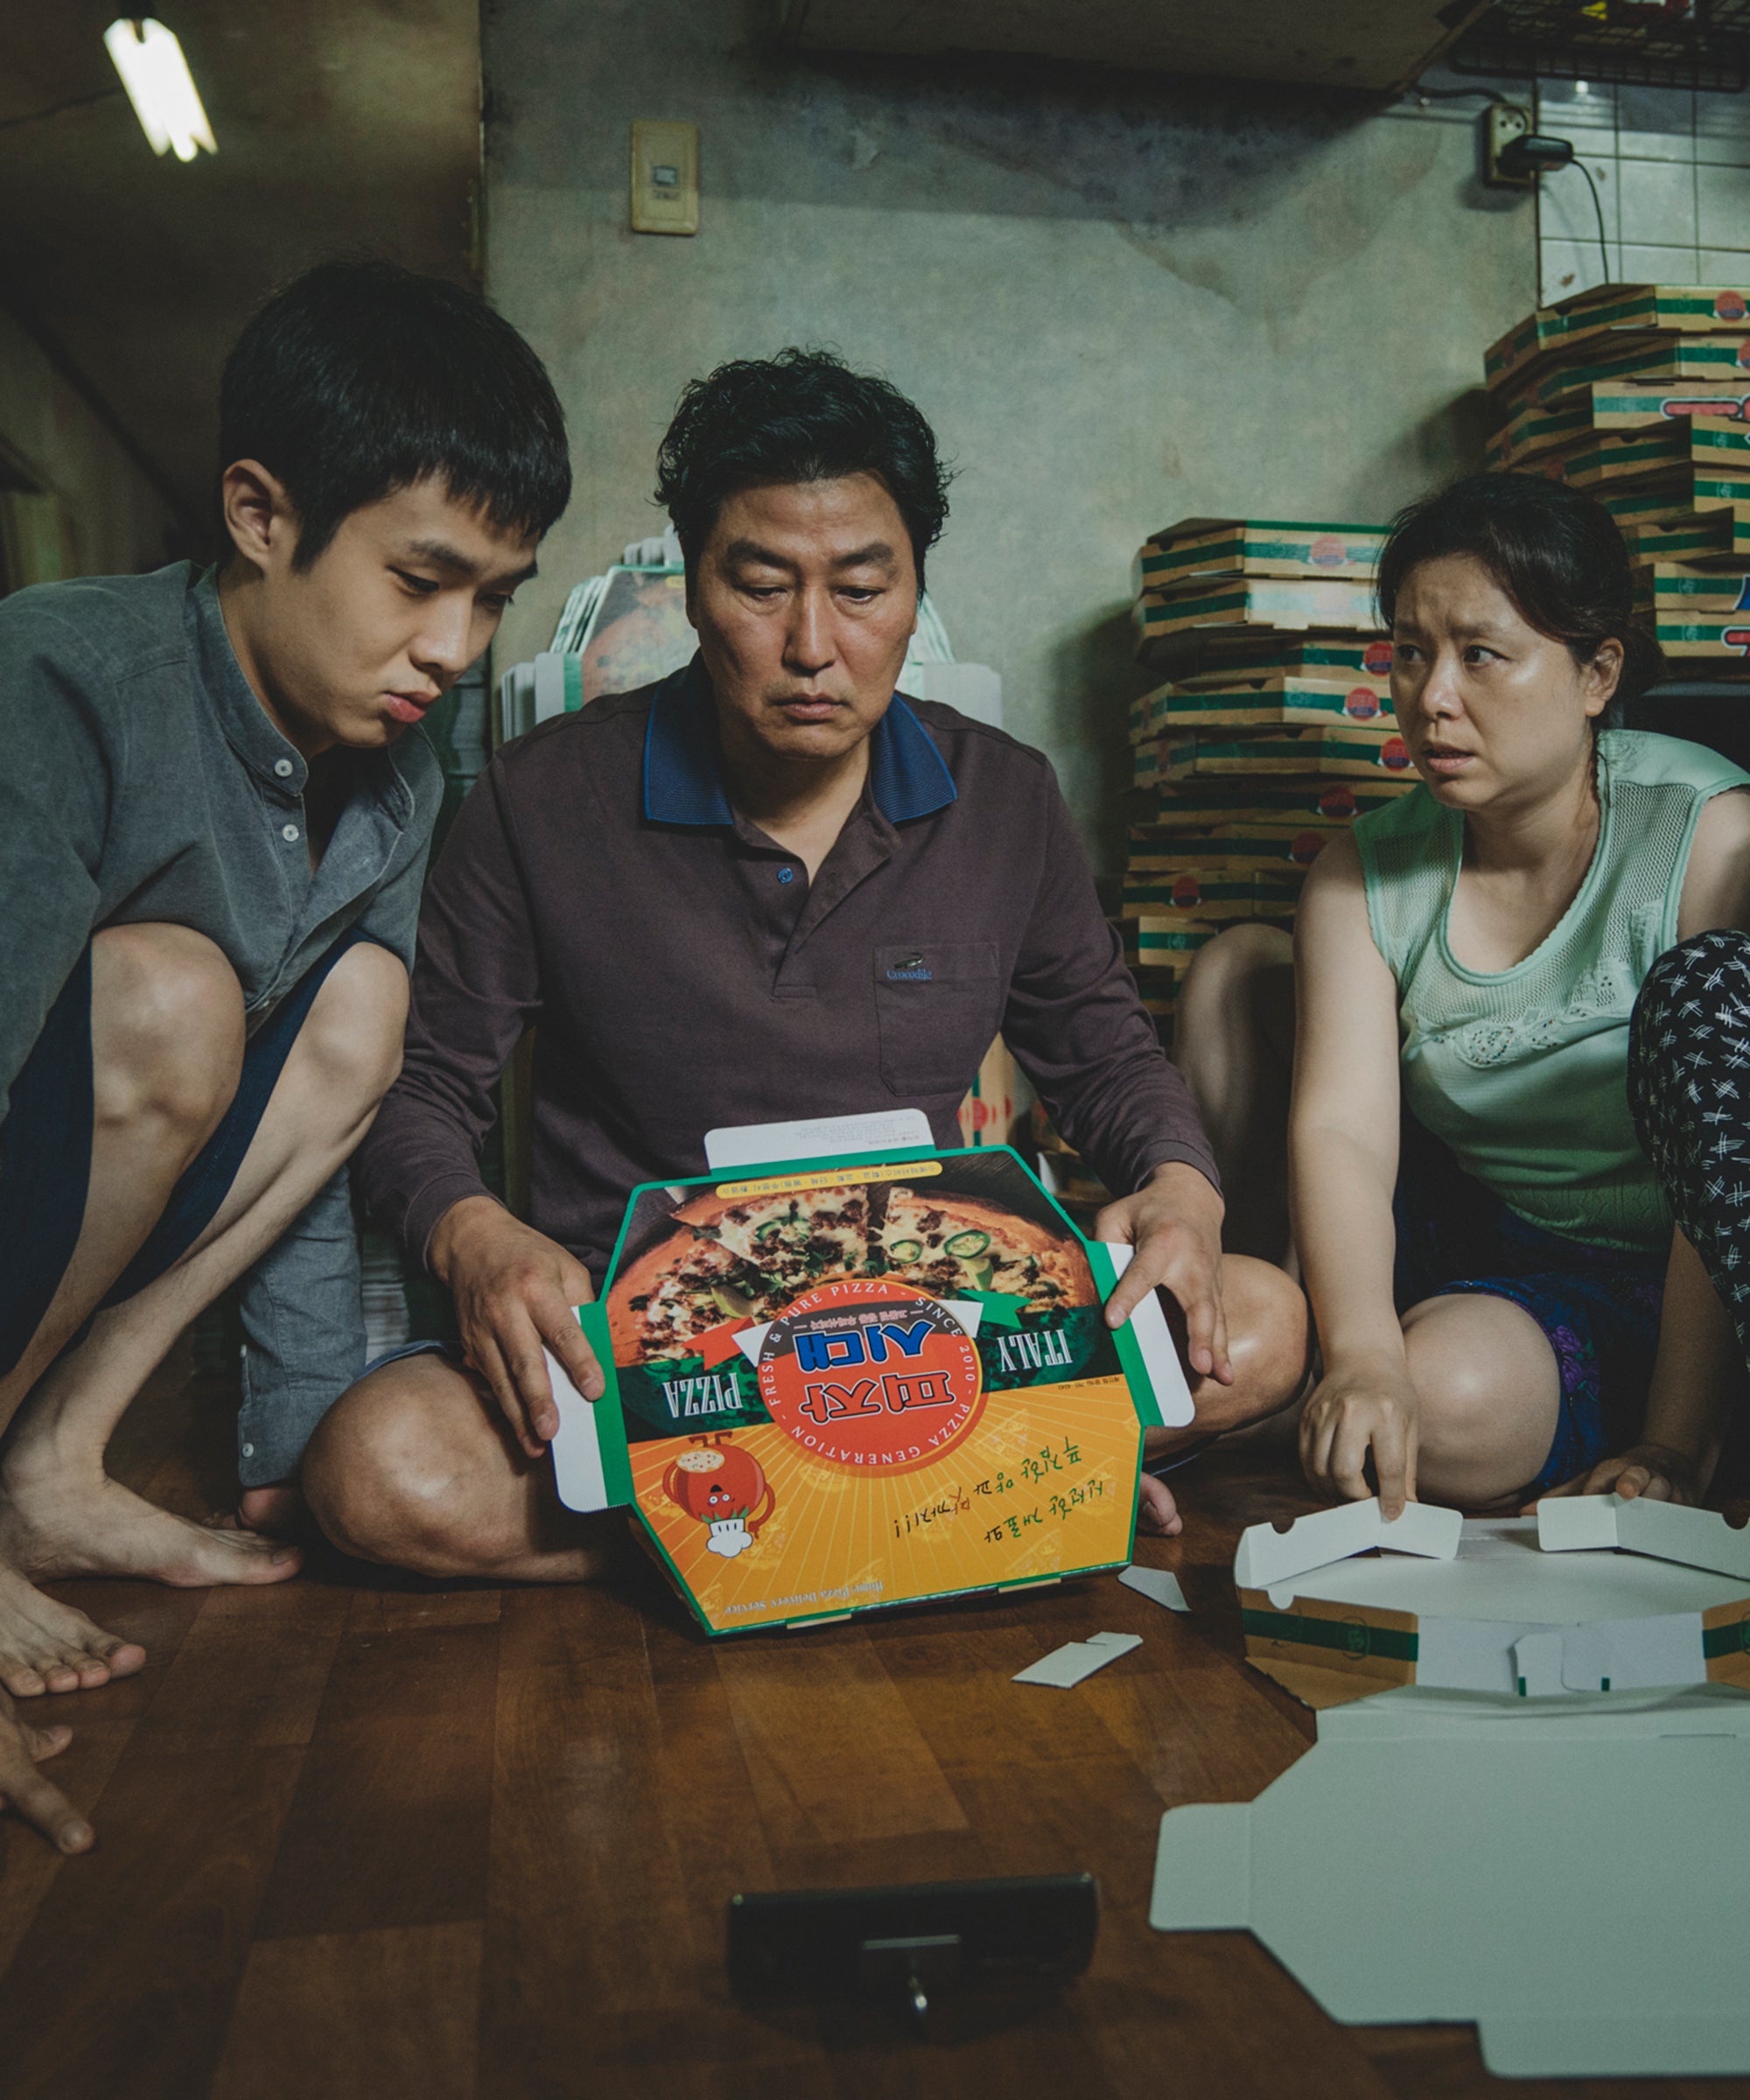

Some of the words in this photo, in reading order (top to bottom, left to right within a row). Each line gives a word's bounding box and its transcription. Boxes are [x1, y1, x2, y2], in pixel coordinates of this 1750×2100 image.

[886, 968, 932, 979] Crocodile
[780, 1293, 822, 1326] PURE
[830, 1283, 888, 1297] PIZZA
[915, 1296, 963, 1338] SINCE
[769, 1332, 782, 1343] &
[793, 1320, 936, 1374] 시대
[997, 1329, 1073, 1372] ITALY
[761, 1352, 781, 1406] FRESH
[959, 1345, 976, 1382] 2010
[662, 1372, 743, 1418] PIZZA
[799, 1370, 956, 1424] 피자
[928, 1403, 971, 1446] PIZZA
[791, 1425, 920, 1465] GENERATION
[1020, 1436, 1082, 1484] 푸짐한
[973, 1472, 1014, 1496] 양과
[1049, 1480, 1103, 1520] 신선한
[893, 1487, 970, 1538] 맛까지!!
[984, 1507, 1043, 1544] 재료와
[725, 1600, 766, 1614] Service
[770, 1592, 817, 1606] Delivery
[821, 1586, 850, 1599] Pizza
